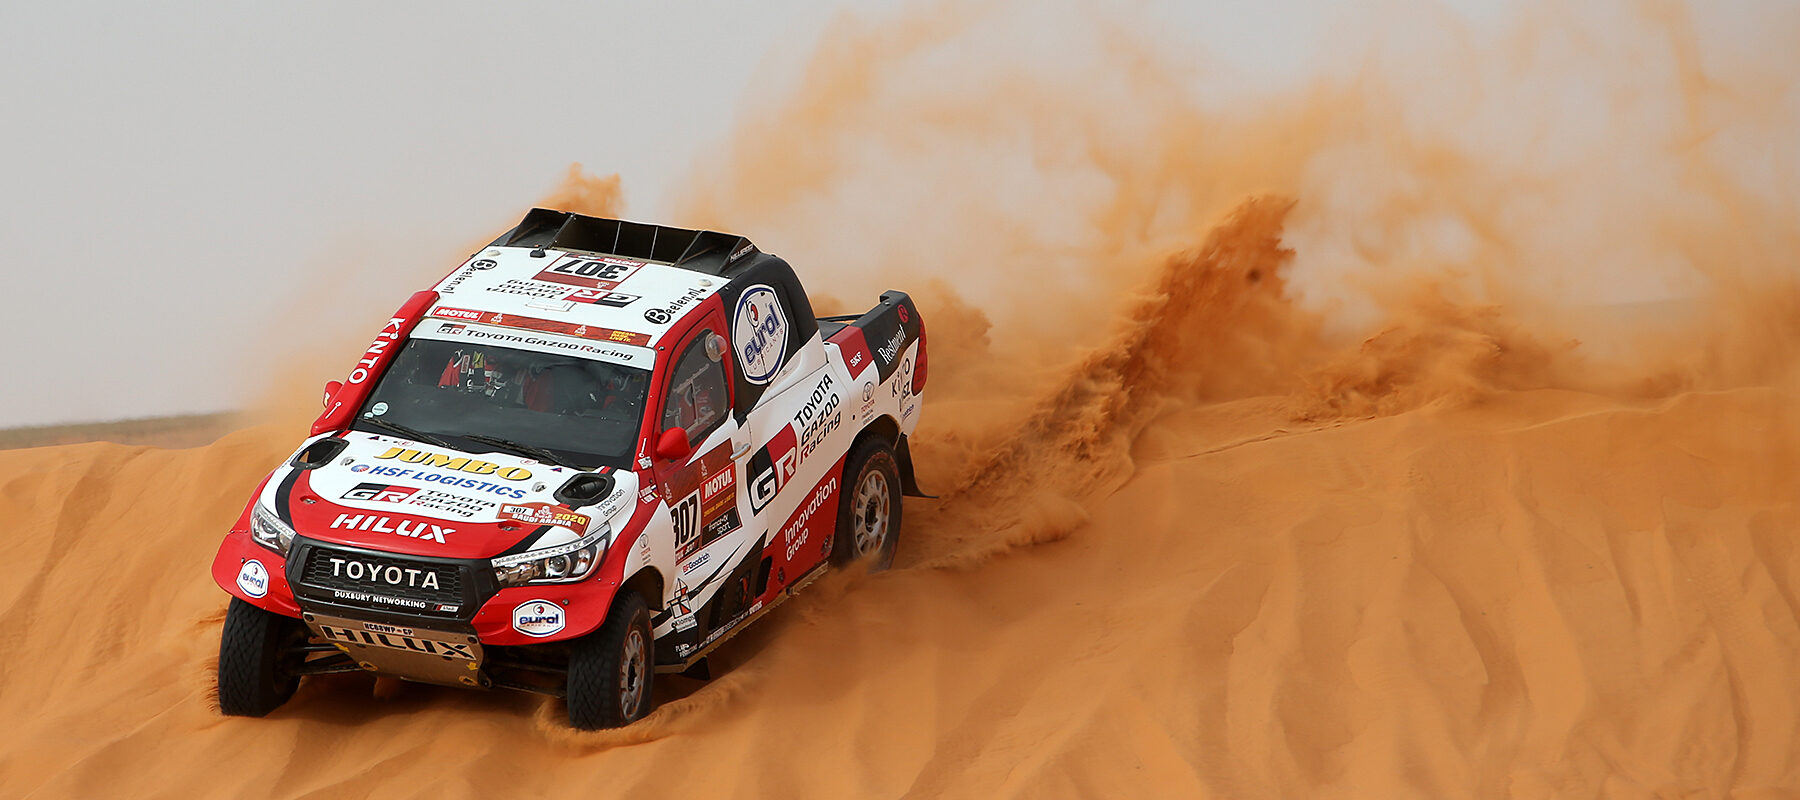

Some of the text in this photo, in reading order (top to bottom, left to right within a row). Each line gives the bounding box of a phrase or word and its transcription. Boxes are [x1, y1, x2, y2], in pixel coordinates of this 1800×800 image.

[441, 259, 498, 294] Beelen.nl
[553, 259, 628, 280] 307
[486, 287, 556, 299] TOYOTA
[499, 283, 565, 295] GAZOO
[436, 308, 479, 319] MOTUL
[644, 288, 701, 324] Beelen.nl
[437, 324, 634, 361] GR TOYOTA GAZOO Racing
[744, 302, 781, 365] eurol
[850, 351, 863, 368] SKF
[793, 374, 834, 428] TOYOTA
[801, 392, 840, 447] GAZOO
[800, 411, 841, 465] Racing
[373, 447, 532, 481] JUMBO
[748, 434, 798, 514] GR
[368, 465, 527, 499] HSF LOGISTICS
[704, 468, 733, 499] MOTUL
[340, 485, 416, 503] GR
[416, 495, 483, 511] GAZOO
[427, 489, 496, 507] TOYOTA
[409, 499, 474, 517] Racing
[510, 506, 527, 514] 307
[602, 505, 617, 517] Group
[329, 513, 457, 544] HILUX
[511, 514, 572, 527] SAUDI ARABIA
[554, 513, 586, 525] 2020
[670, 493, 698, 549] 307
[717, 521, 731, 536] sport
[786, 527, 809, 561] Group
[683, 552, 711, 573] BFGoodrich
[242, 573, 265, 589] eurol
[329, 558, 440, 590] TOYOTA
[334, 590, 371, 602] DUXBURY
[373, 595, 426, 609] NETWORKING
[519, 613, 559, 625] eurol
[322, 626, 474, 659] HILUX
